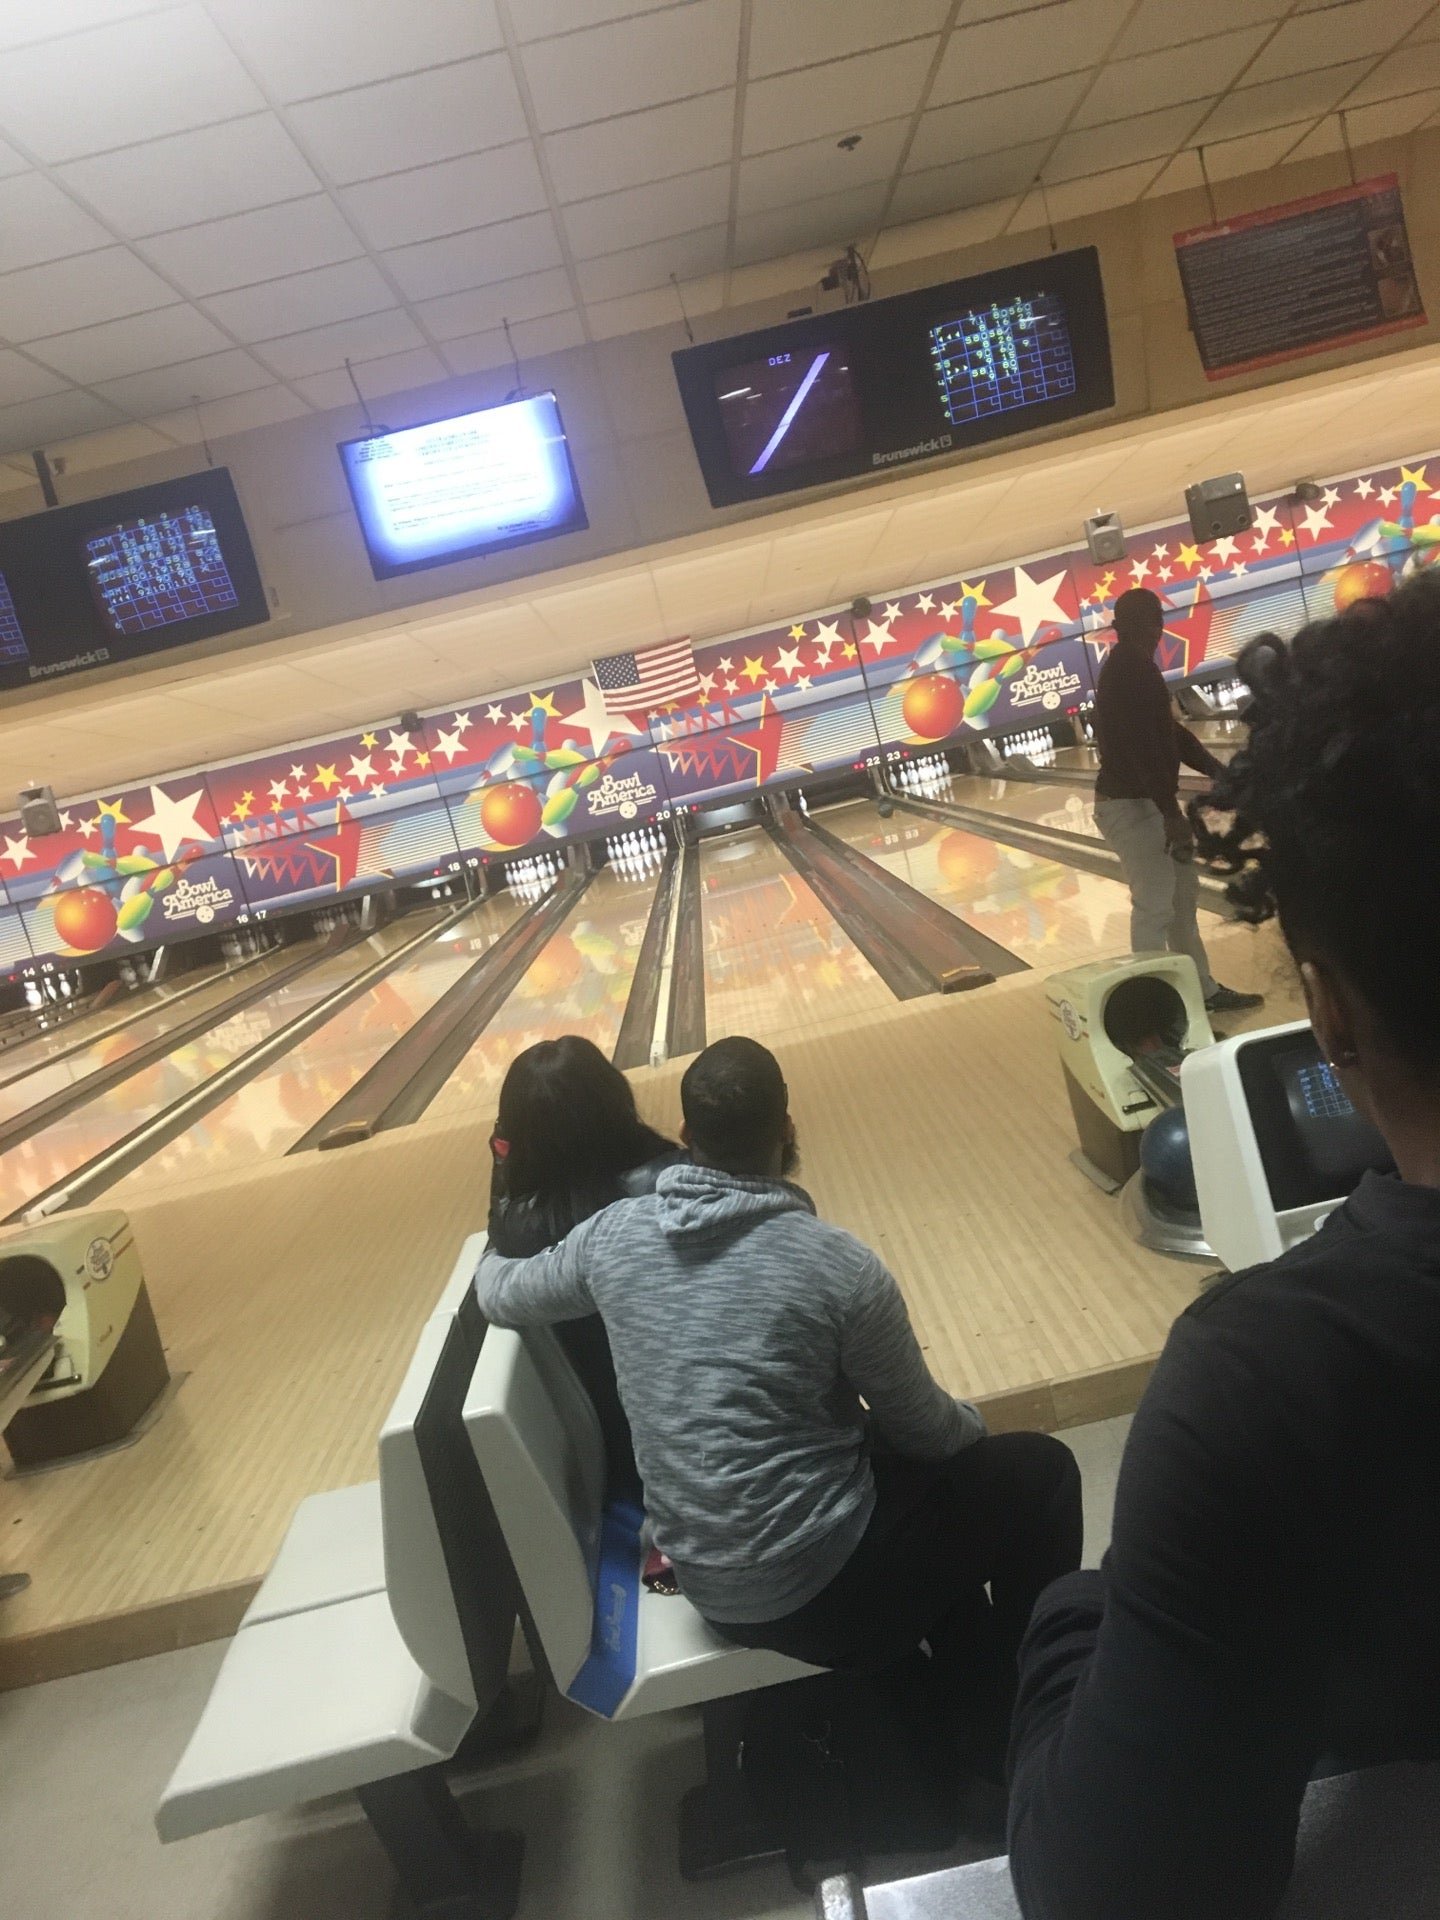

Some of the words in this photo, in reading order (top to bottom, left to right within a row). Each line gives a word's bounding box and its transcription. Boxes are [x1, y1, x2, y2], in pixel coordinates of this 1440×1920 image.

[873, 438, 939, 465] Brunswick
[28, 651, 97, 678] Brunswick
[1023, 661, 1066, 685] Bowl
[1010, 674, 1080, 703] America
[1080, 700, 1094, 711] 24
[866, 756, 881, 767] 22
[886, 751, 901, 762] 23
[600, 771, 642, 796] Bowl
[587, 784, 656, 812] America
[656, 810, 671, 821] 20
[675, 805, 689, 816] 21
[448, 862, 461, 872] 18
[466, 857, 479, 868] 19
[176, 876, 218, 899] Bowl
[162, 888, 233, 916] America
[236, 914, 249, 924] 16
[255, 910, 267, 920] 17
[22, 967, 36, 978] 14
[41, 962, 54, 973] 15
